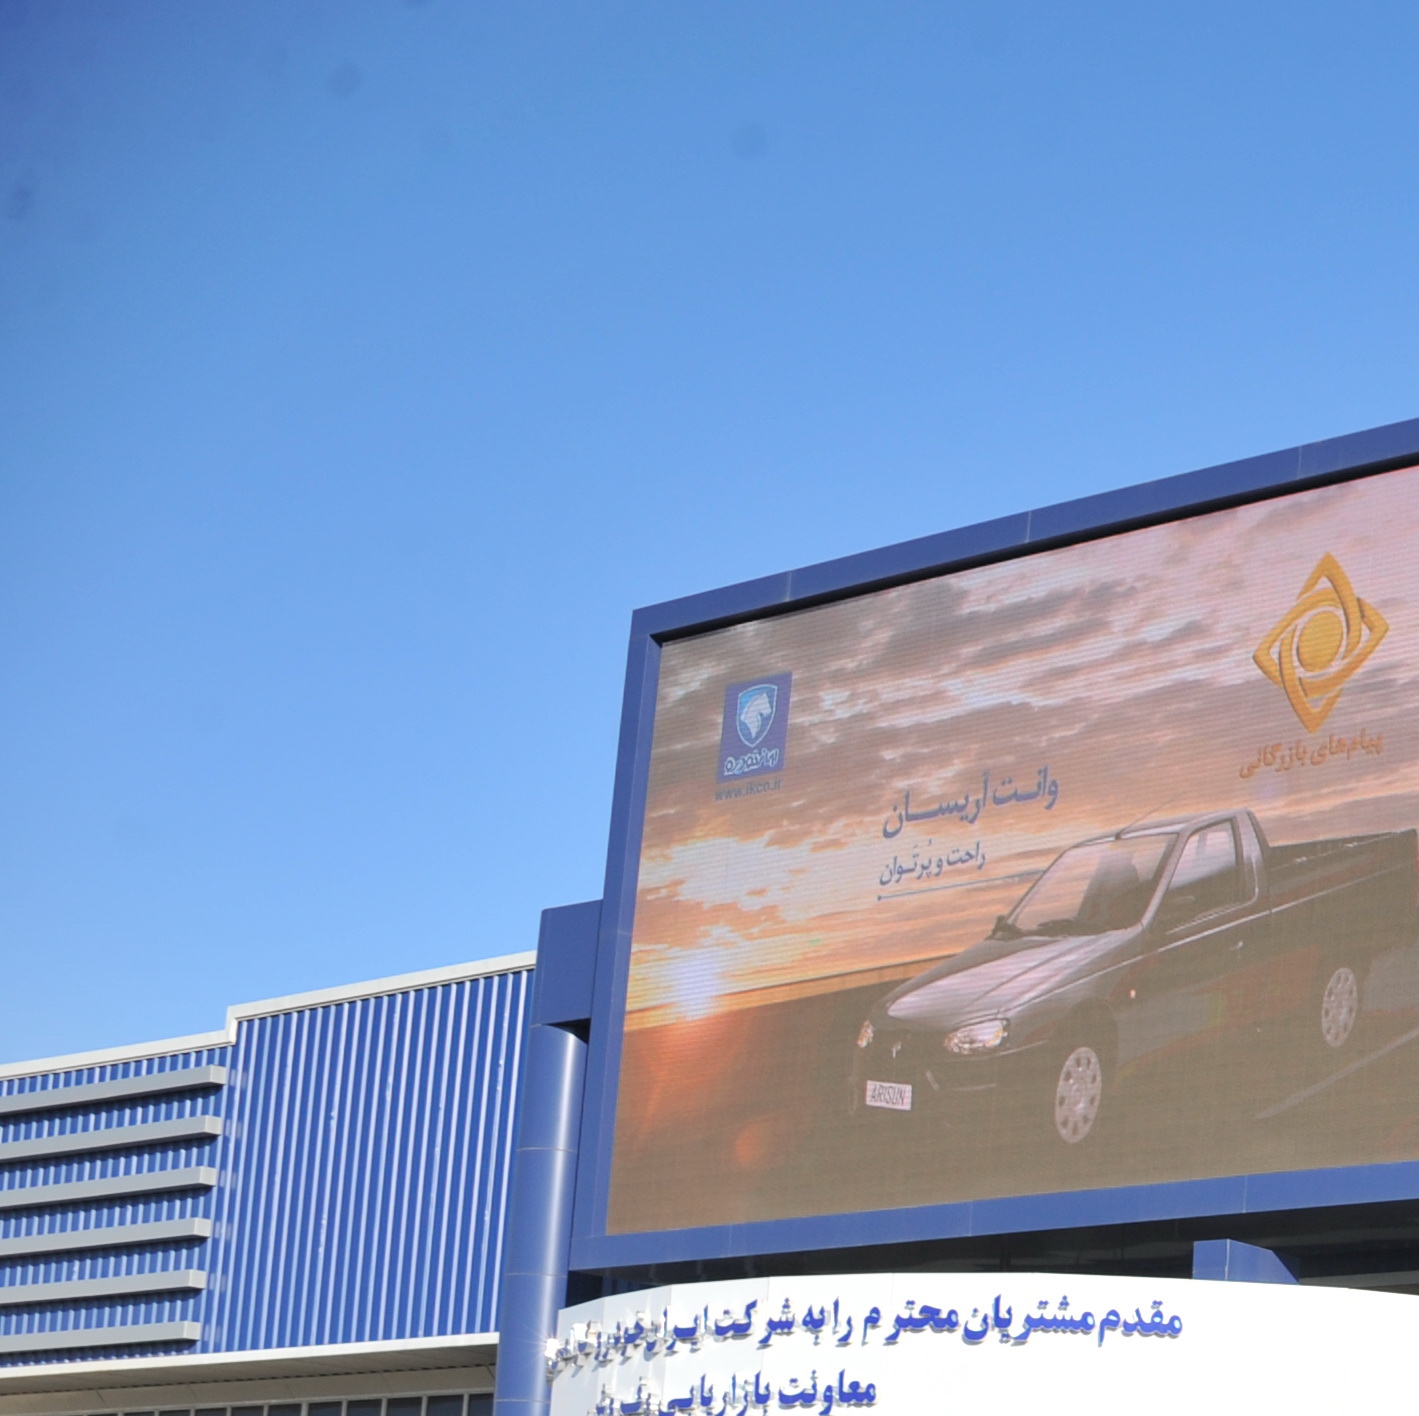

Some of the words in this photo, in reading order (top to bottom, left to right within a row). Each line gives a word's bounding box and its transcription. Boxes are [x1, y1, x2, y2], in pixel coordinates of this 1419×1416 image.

[1239, 739, 1308, 779] بازرگانی
[714, 778, 784, 801] www.ikco.ir
[882, 769, 990, 839] آریسان
[992, 765, 1059, 810] وانت
[934, 856, 944, 877] و
[946, 841, 986, 870] راحت
[870, 1084, 906, 1106] ARISUN
[713, 1299, 797, 1346] شرکت
[802, 1305, 826, 1345] به
[833, 1296, 852, 1344] را
[861, 1300, 960, 1346] محترم
[962, 1294, 1096, 1346] مشتریان
[1098, 1300, 1183, 1348] مقدم
[778, 1369, 878, 1416] معاونت
